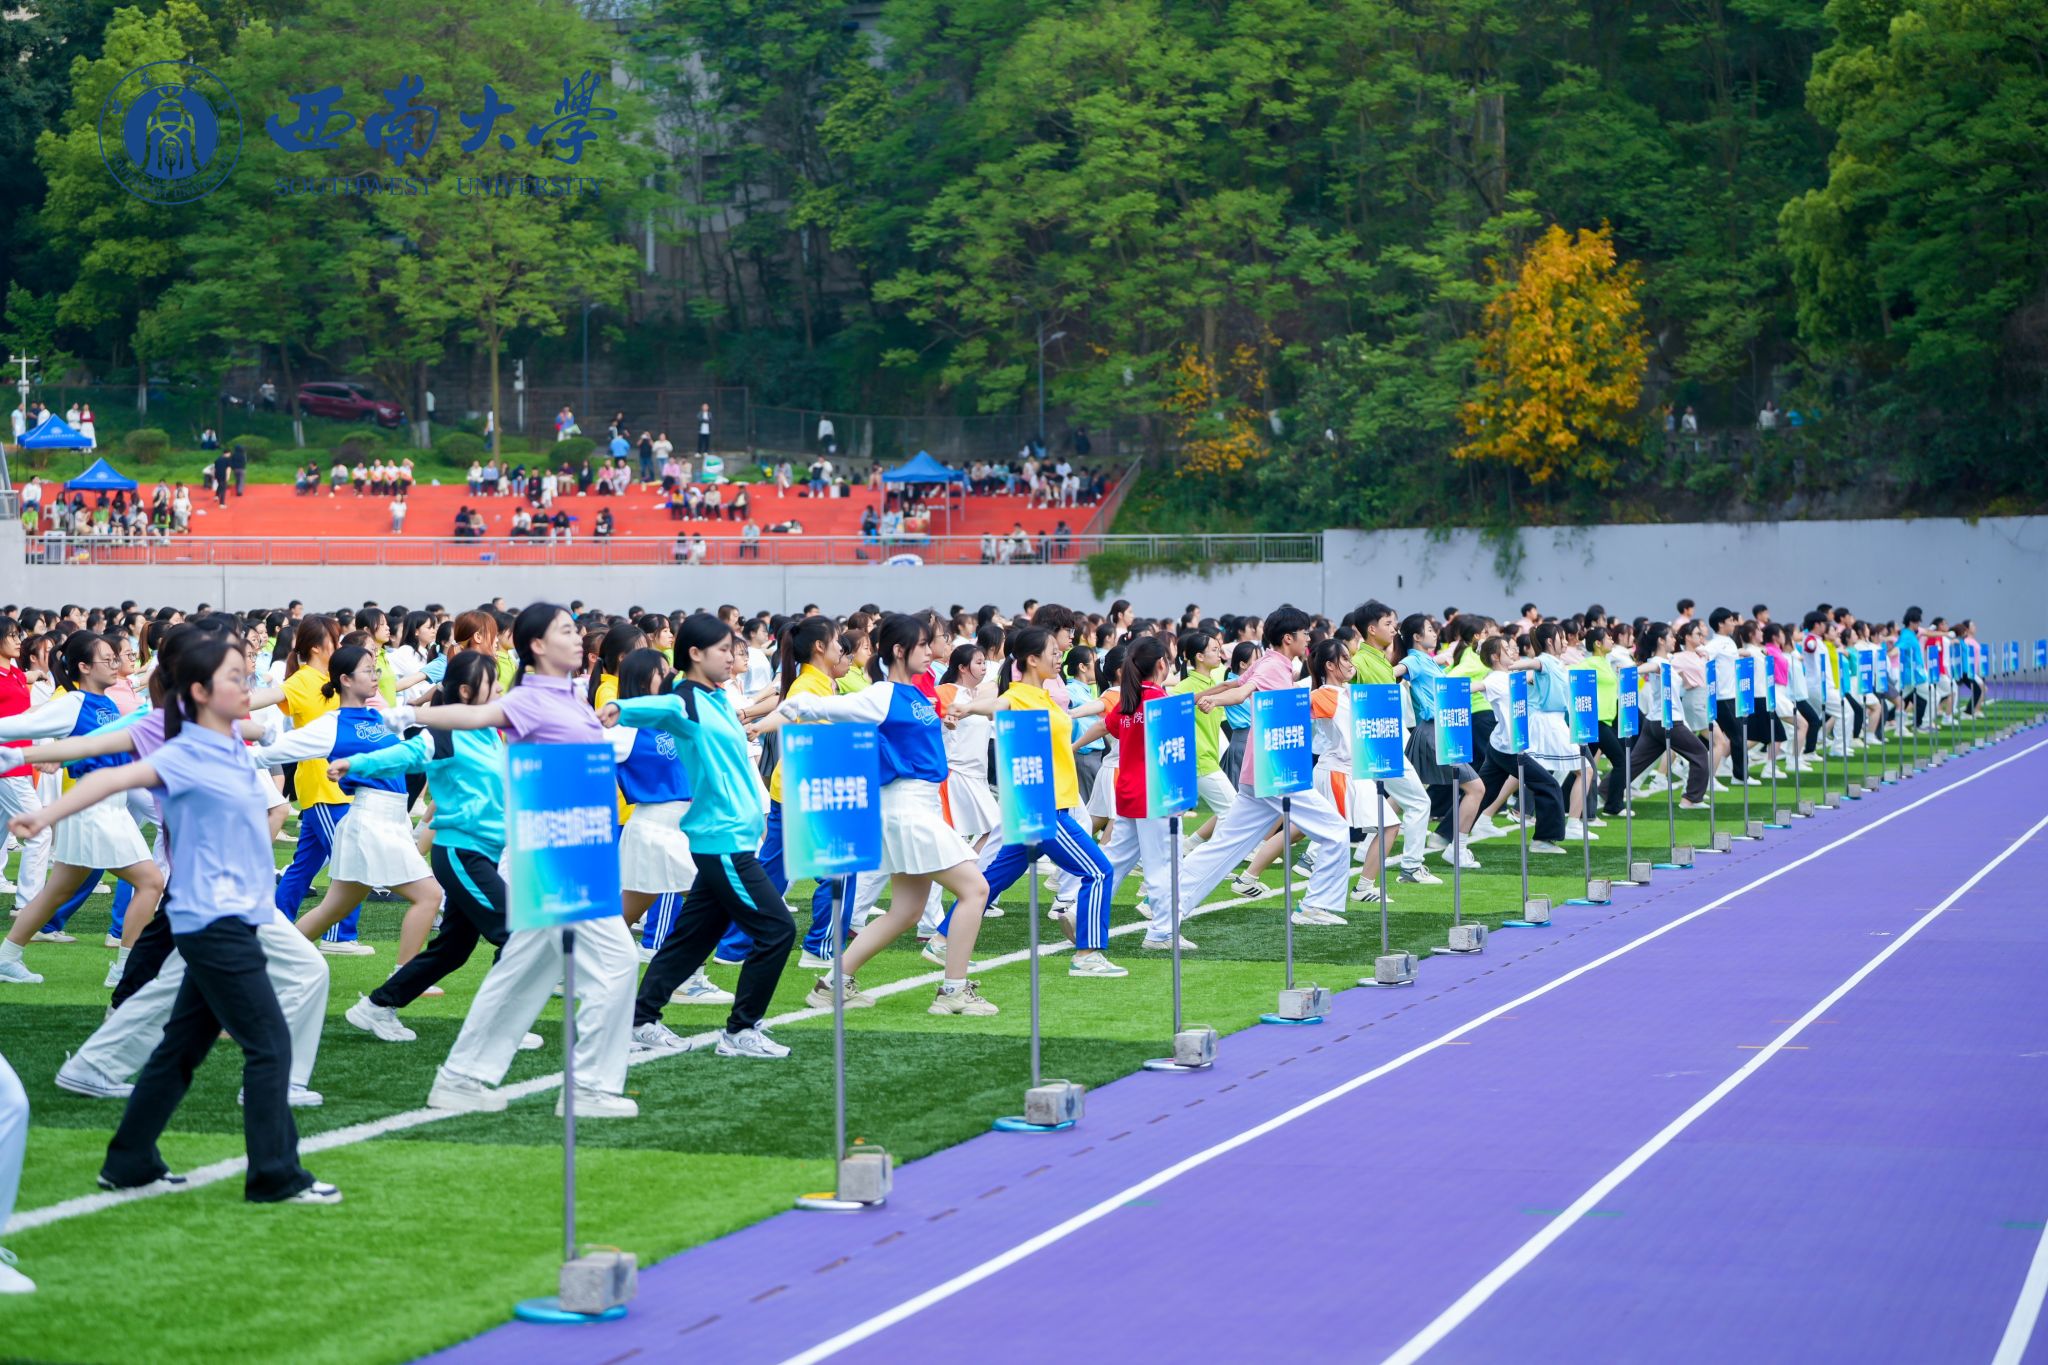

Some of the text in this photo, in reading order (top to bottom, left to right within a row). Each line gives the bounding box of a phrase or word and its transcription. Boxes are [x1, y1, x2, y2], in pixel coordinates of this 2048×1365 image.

[1158, 735, 1186, 767] 水产学院
[1263, 724, 1305, 751] 地理科学学院
[798, 775, 869, 812] 食品科学学院
